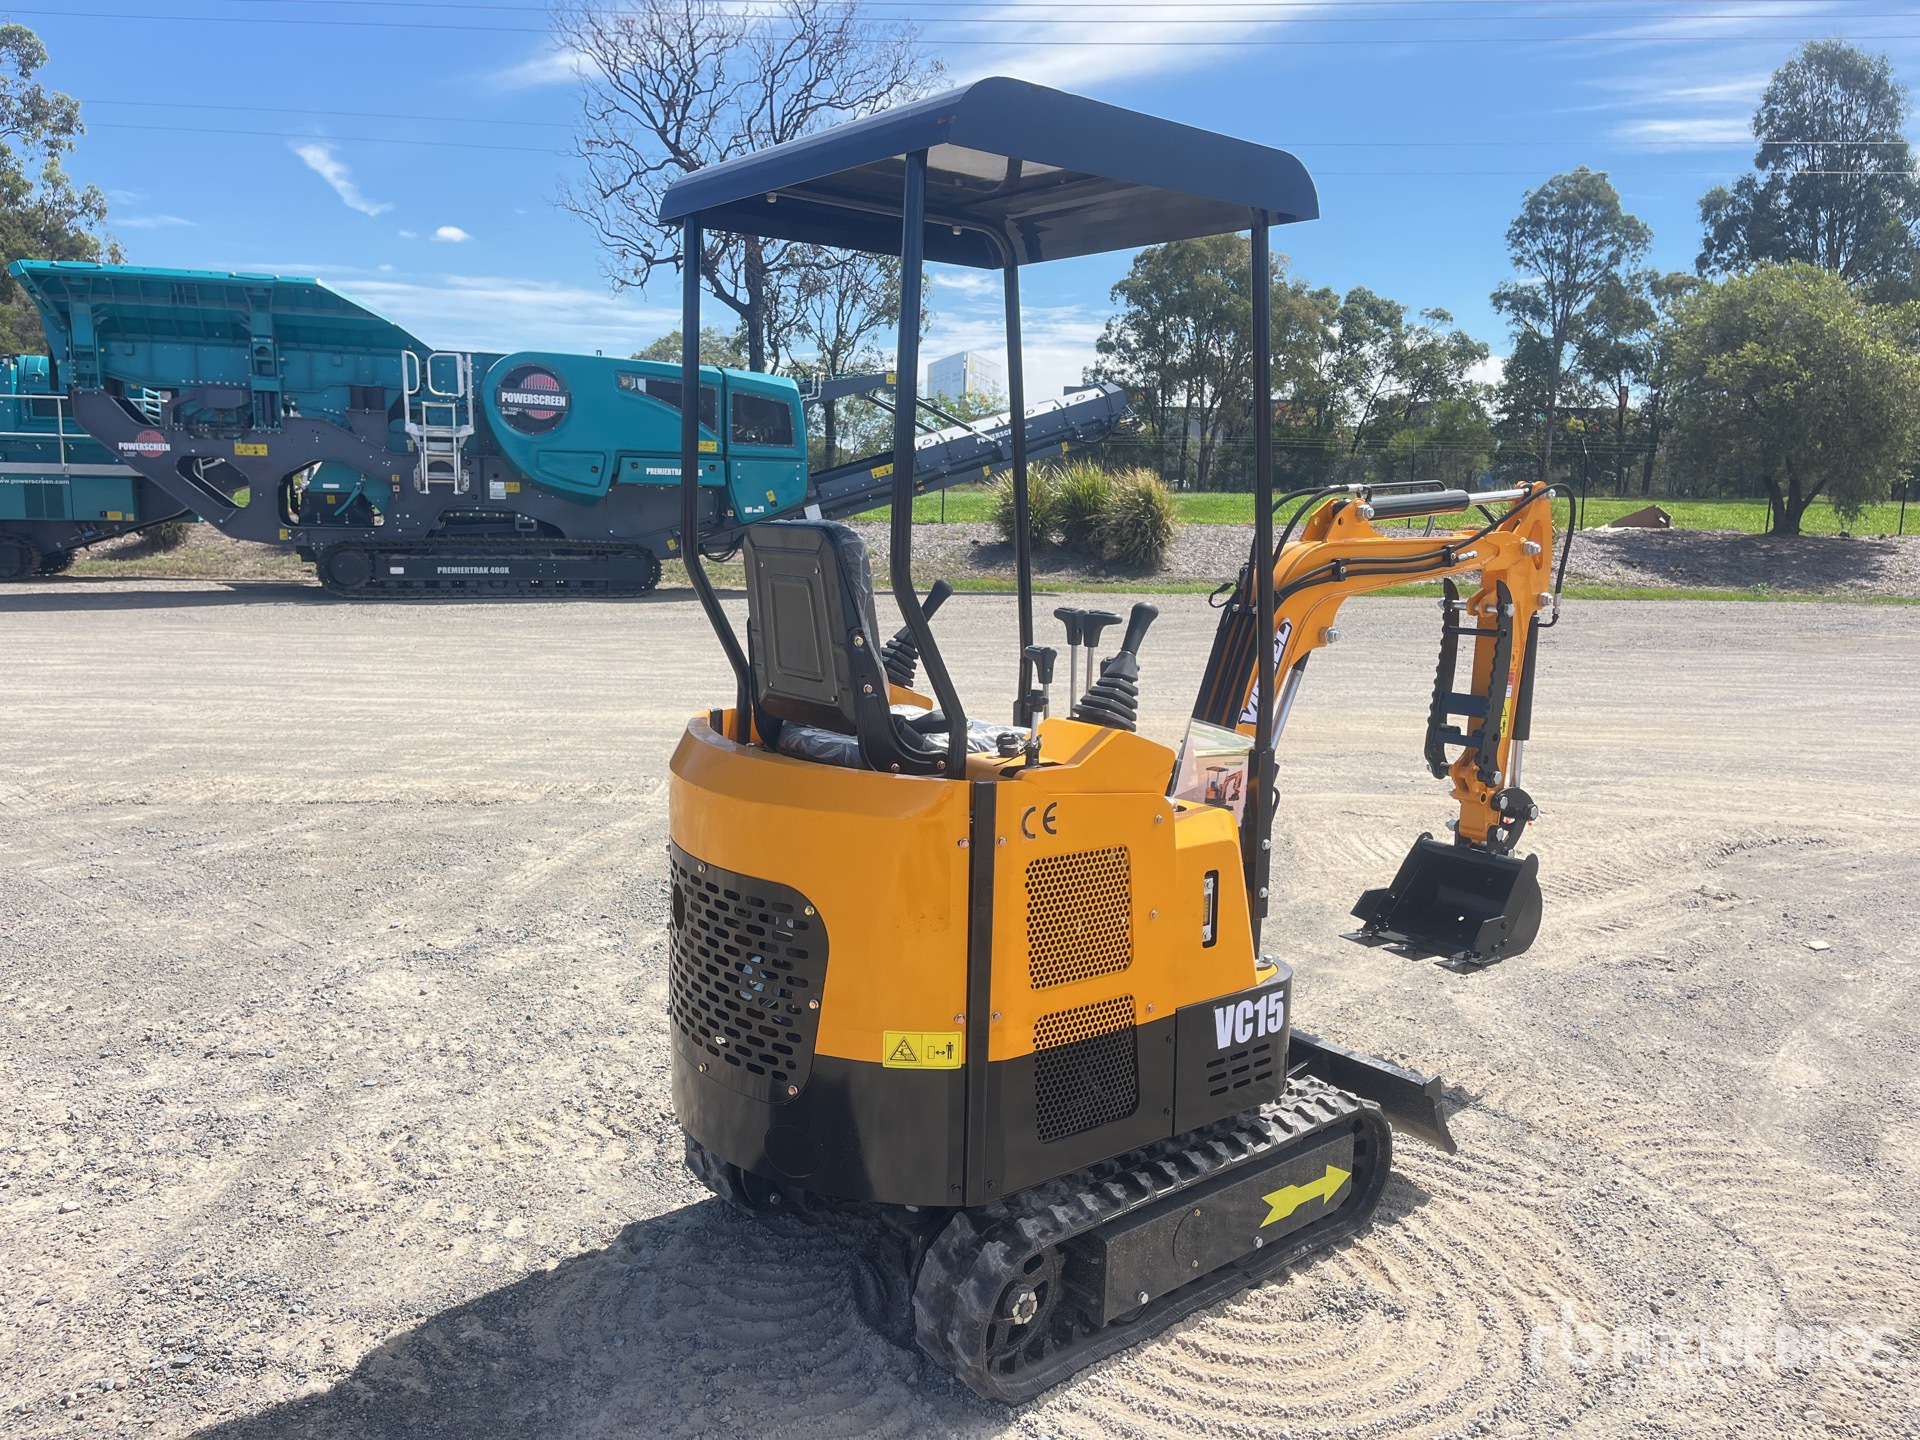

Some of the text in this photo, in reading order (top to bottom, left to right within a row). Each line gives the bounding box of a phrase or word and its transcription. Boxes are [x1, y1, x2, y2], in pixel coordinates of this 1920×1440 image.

[501, 391, 566, 407] POWERSCREEN
[118, 442, 171, 452] POWERSCREEN
[437, 566, 510, 574] PREMIERTRAK 400X
[1021, 801, 1058, 840] CE
[1214, 989, 1285, 1050] VC15
